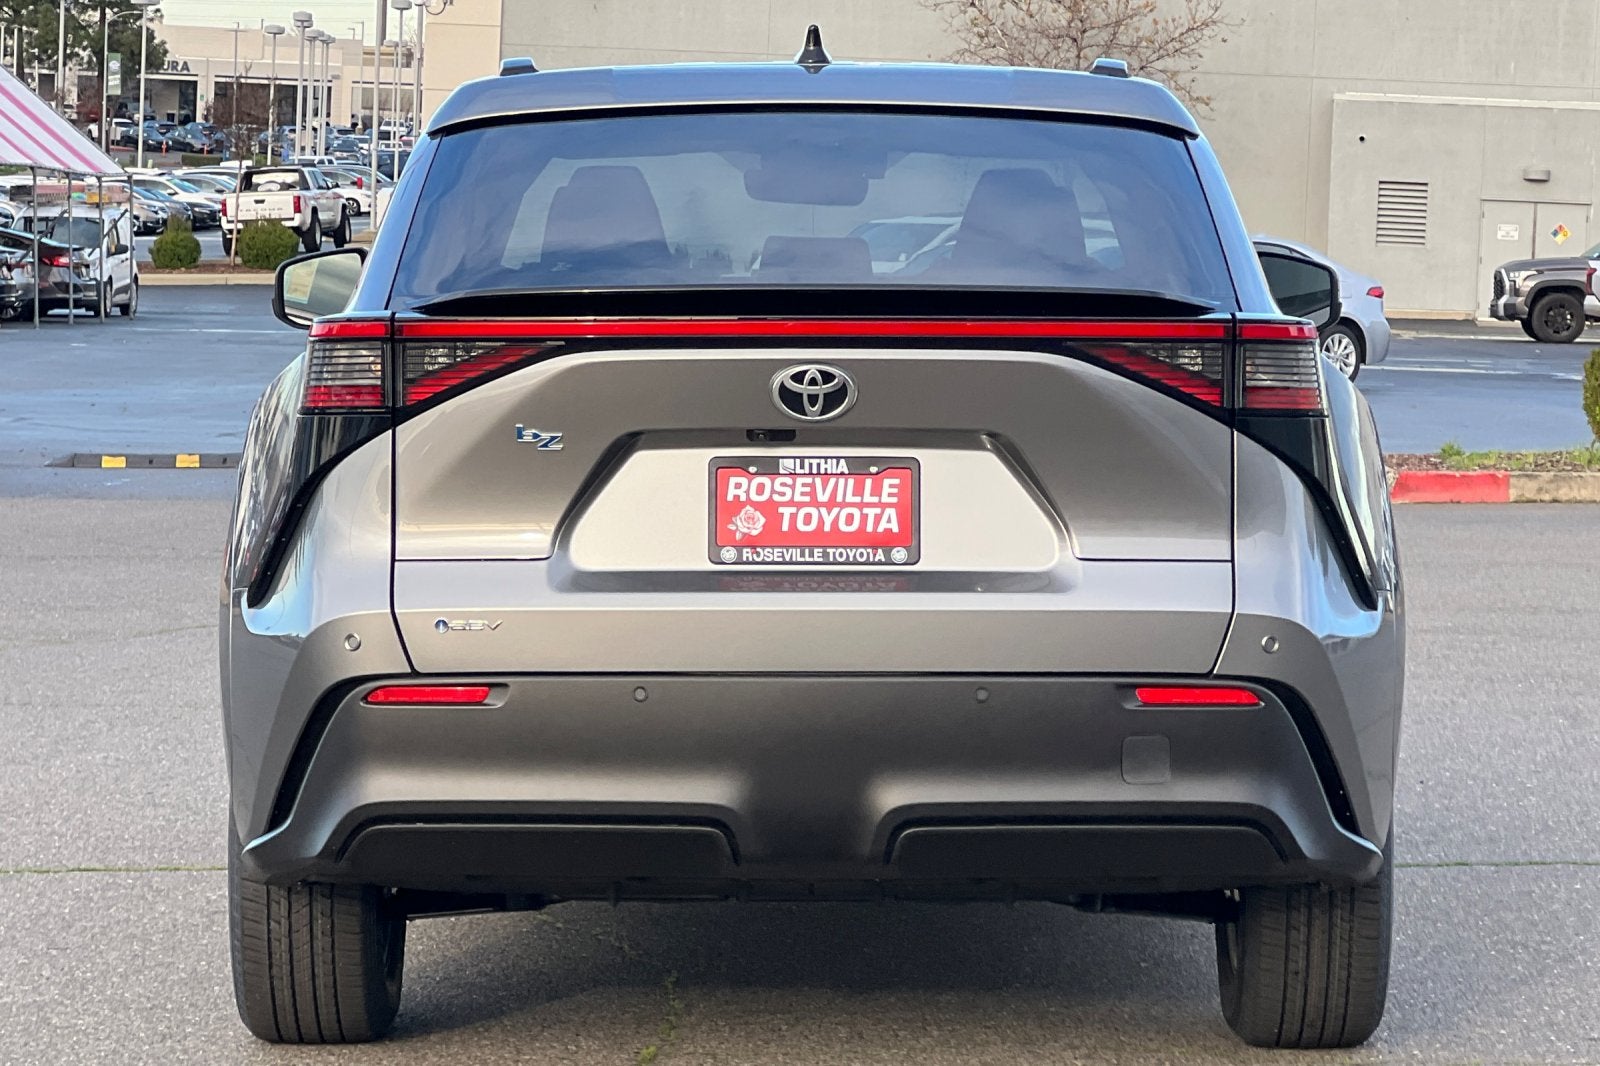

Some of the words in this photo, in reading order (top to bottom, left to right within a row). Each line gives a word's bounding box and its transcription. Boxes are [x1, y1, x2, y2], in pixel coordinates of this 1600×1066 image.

[162, 60, 190, 72] URA
[795, 458, 849, 474] LITHIA
[726, 476, 900, 503] ROSEVILLE
[778, 506, 899, 533] TOYOTA
[742, 547, 824, 562] ROSEVILLE
[826, 548, 885, 562] TOYOTA
